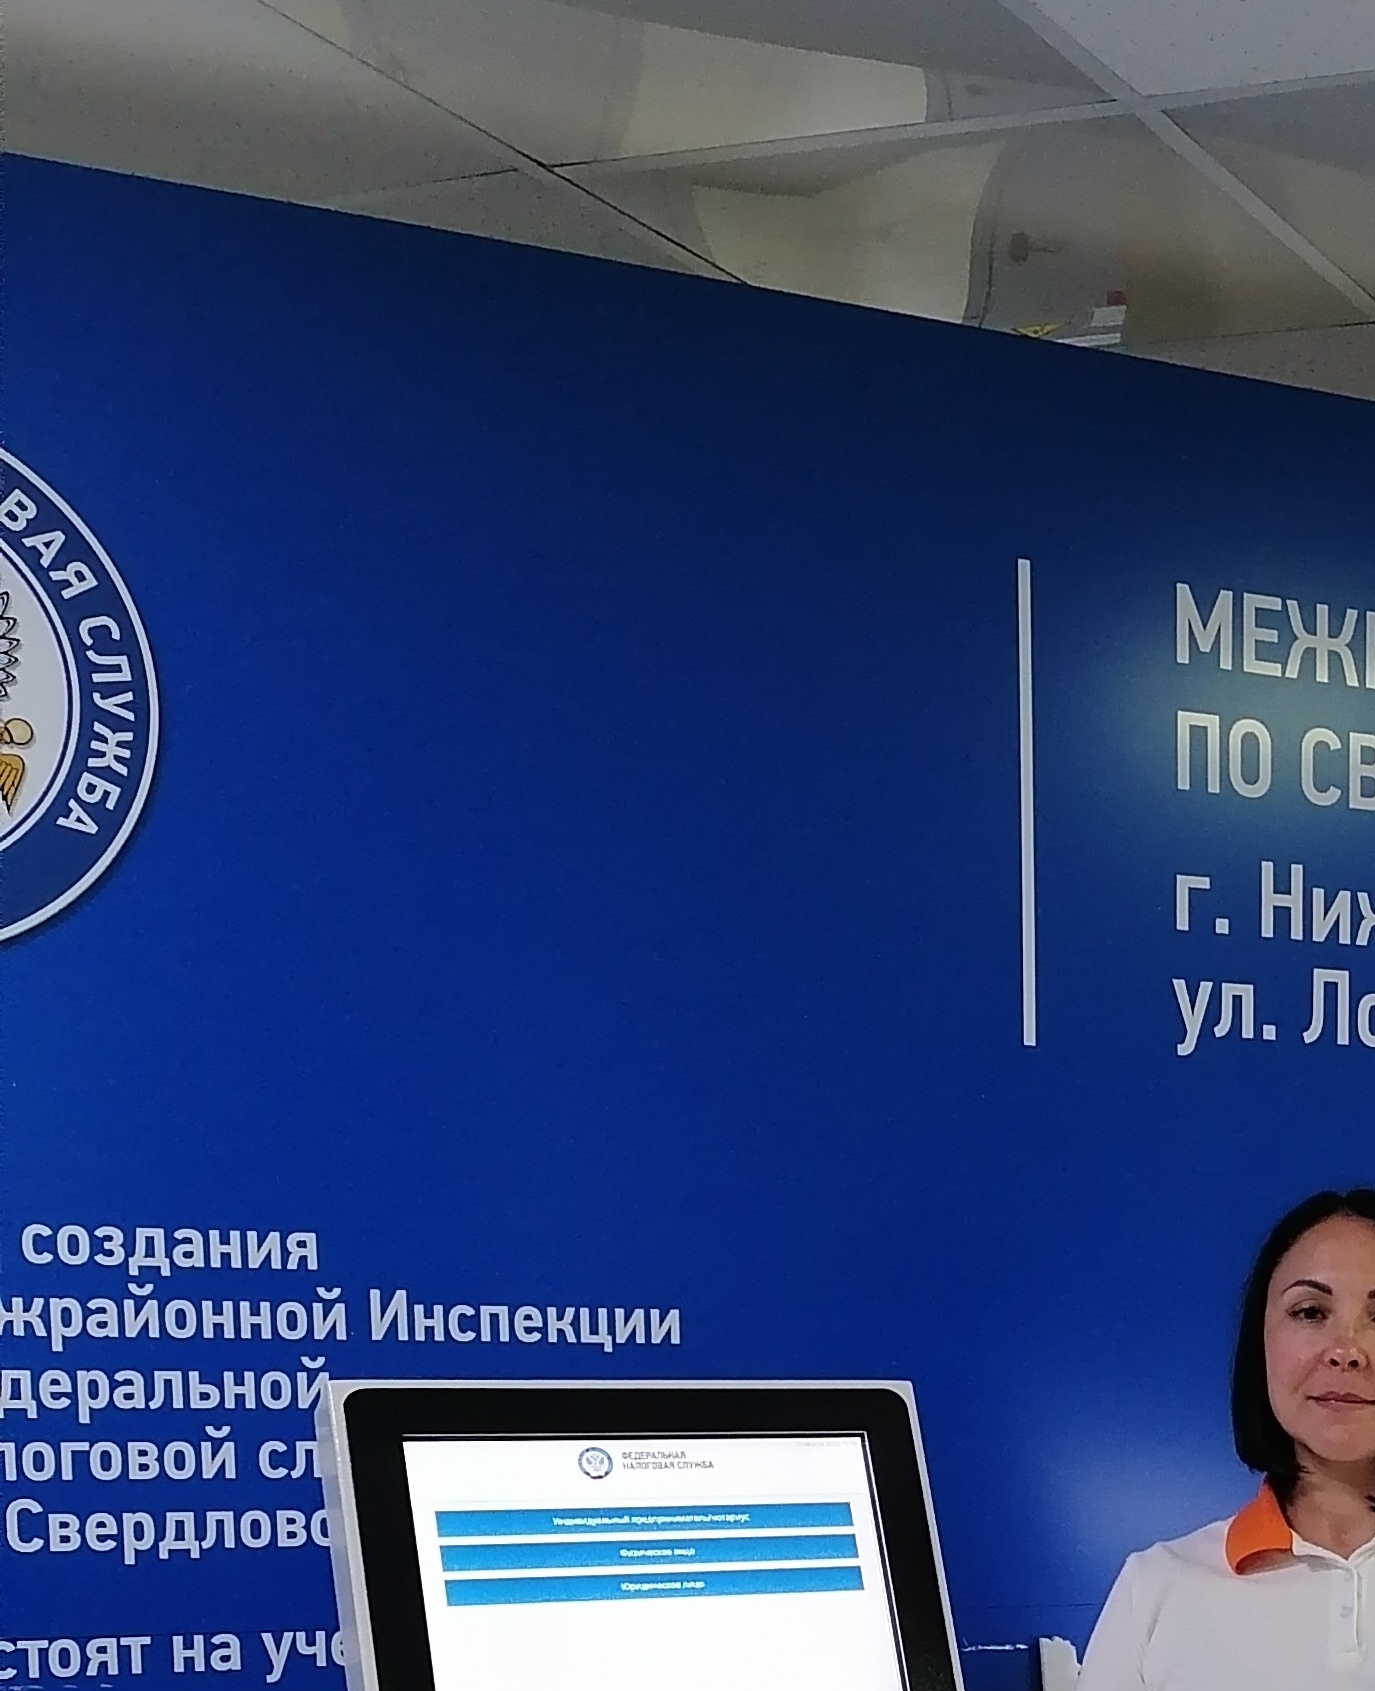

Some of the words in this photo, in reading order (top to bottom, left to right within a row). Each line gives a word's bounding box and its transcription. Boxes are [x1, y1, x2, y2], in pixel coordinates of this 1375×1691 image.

[56, 615, 135, 836] СЛУЖБА
[1176, 710, 1272, 799] ПО
[1174, 873, 1229, 937] г.
[1172, 975, 1277, 1056] ул.
[21, 1224, 319, 1276] создания
[368, 1289, 681, 1352] Инспекции
[172, 1632, 242, 1675] на
